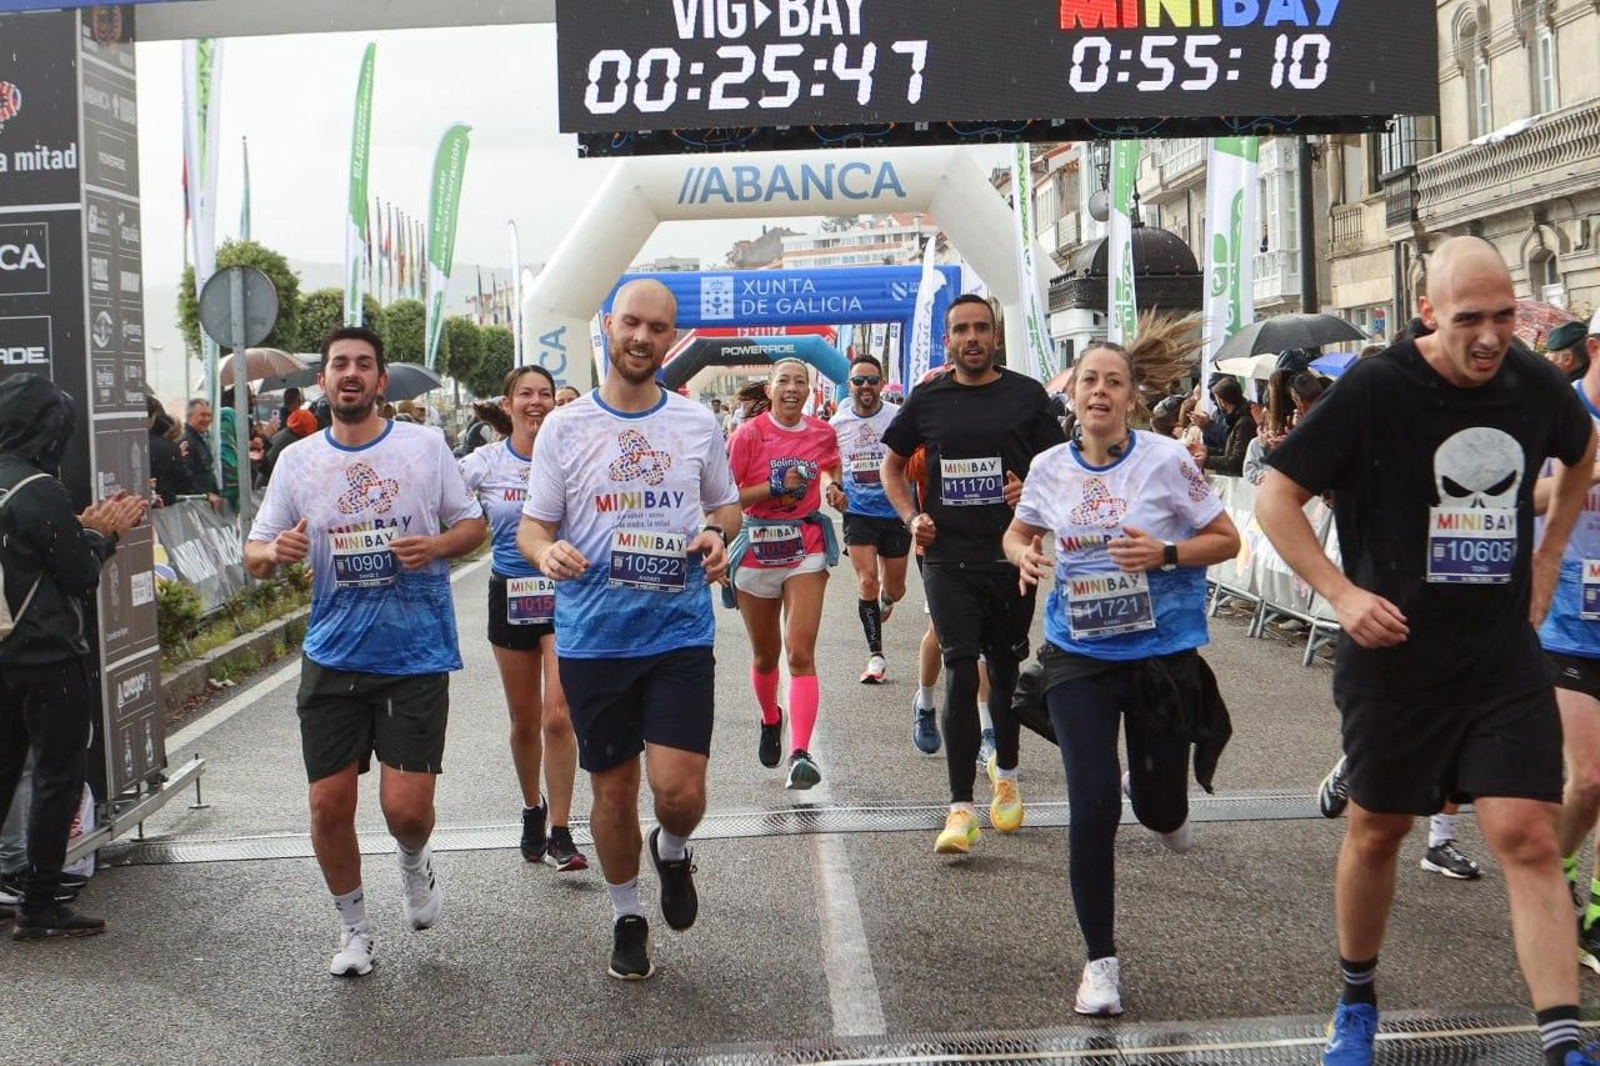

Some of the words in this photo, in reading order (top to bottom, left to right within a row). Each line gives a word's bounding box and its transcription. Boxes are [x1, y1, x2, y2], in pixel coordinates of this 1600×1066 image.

[14, 142, 77, 171] mitad
[742, 277, 817, 296] XUNTA
[741, 299, 768, 316] DE
[776, 296, 863, 315] GALICIA
[721, 344, 796, 357] POWERADE
[945, 460, 996, 474] MINIBAY
[951, 477, 996, 492] 11170
[595, 491, 684, 512] MINIBAY
[335, 532, 393, 550] MINIBAY
[619, 533, 683, 551] MINIBAY
[1447, 540, 1512, 562] 10605
[345, 553, 392, 572] 10901
[626, 554, 680, 576] 10522
[511, 580, 554, 593] MINIBA
[1072, 574, 1139, 596] MINIBAY
